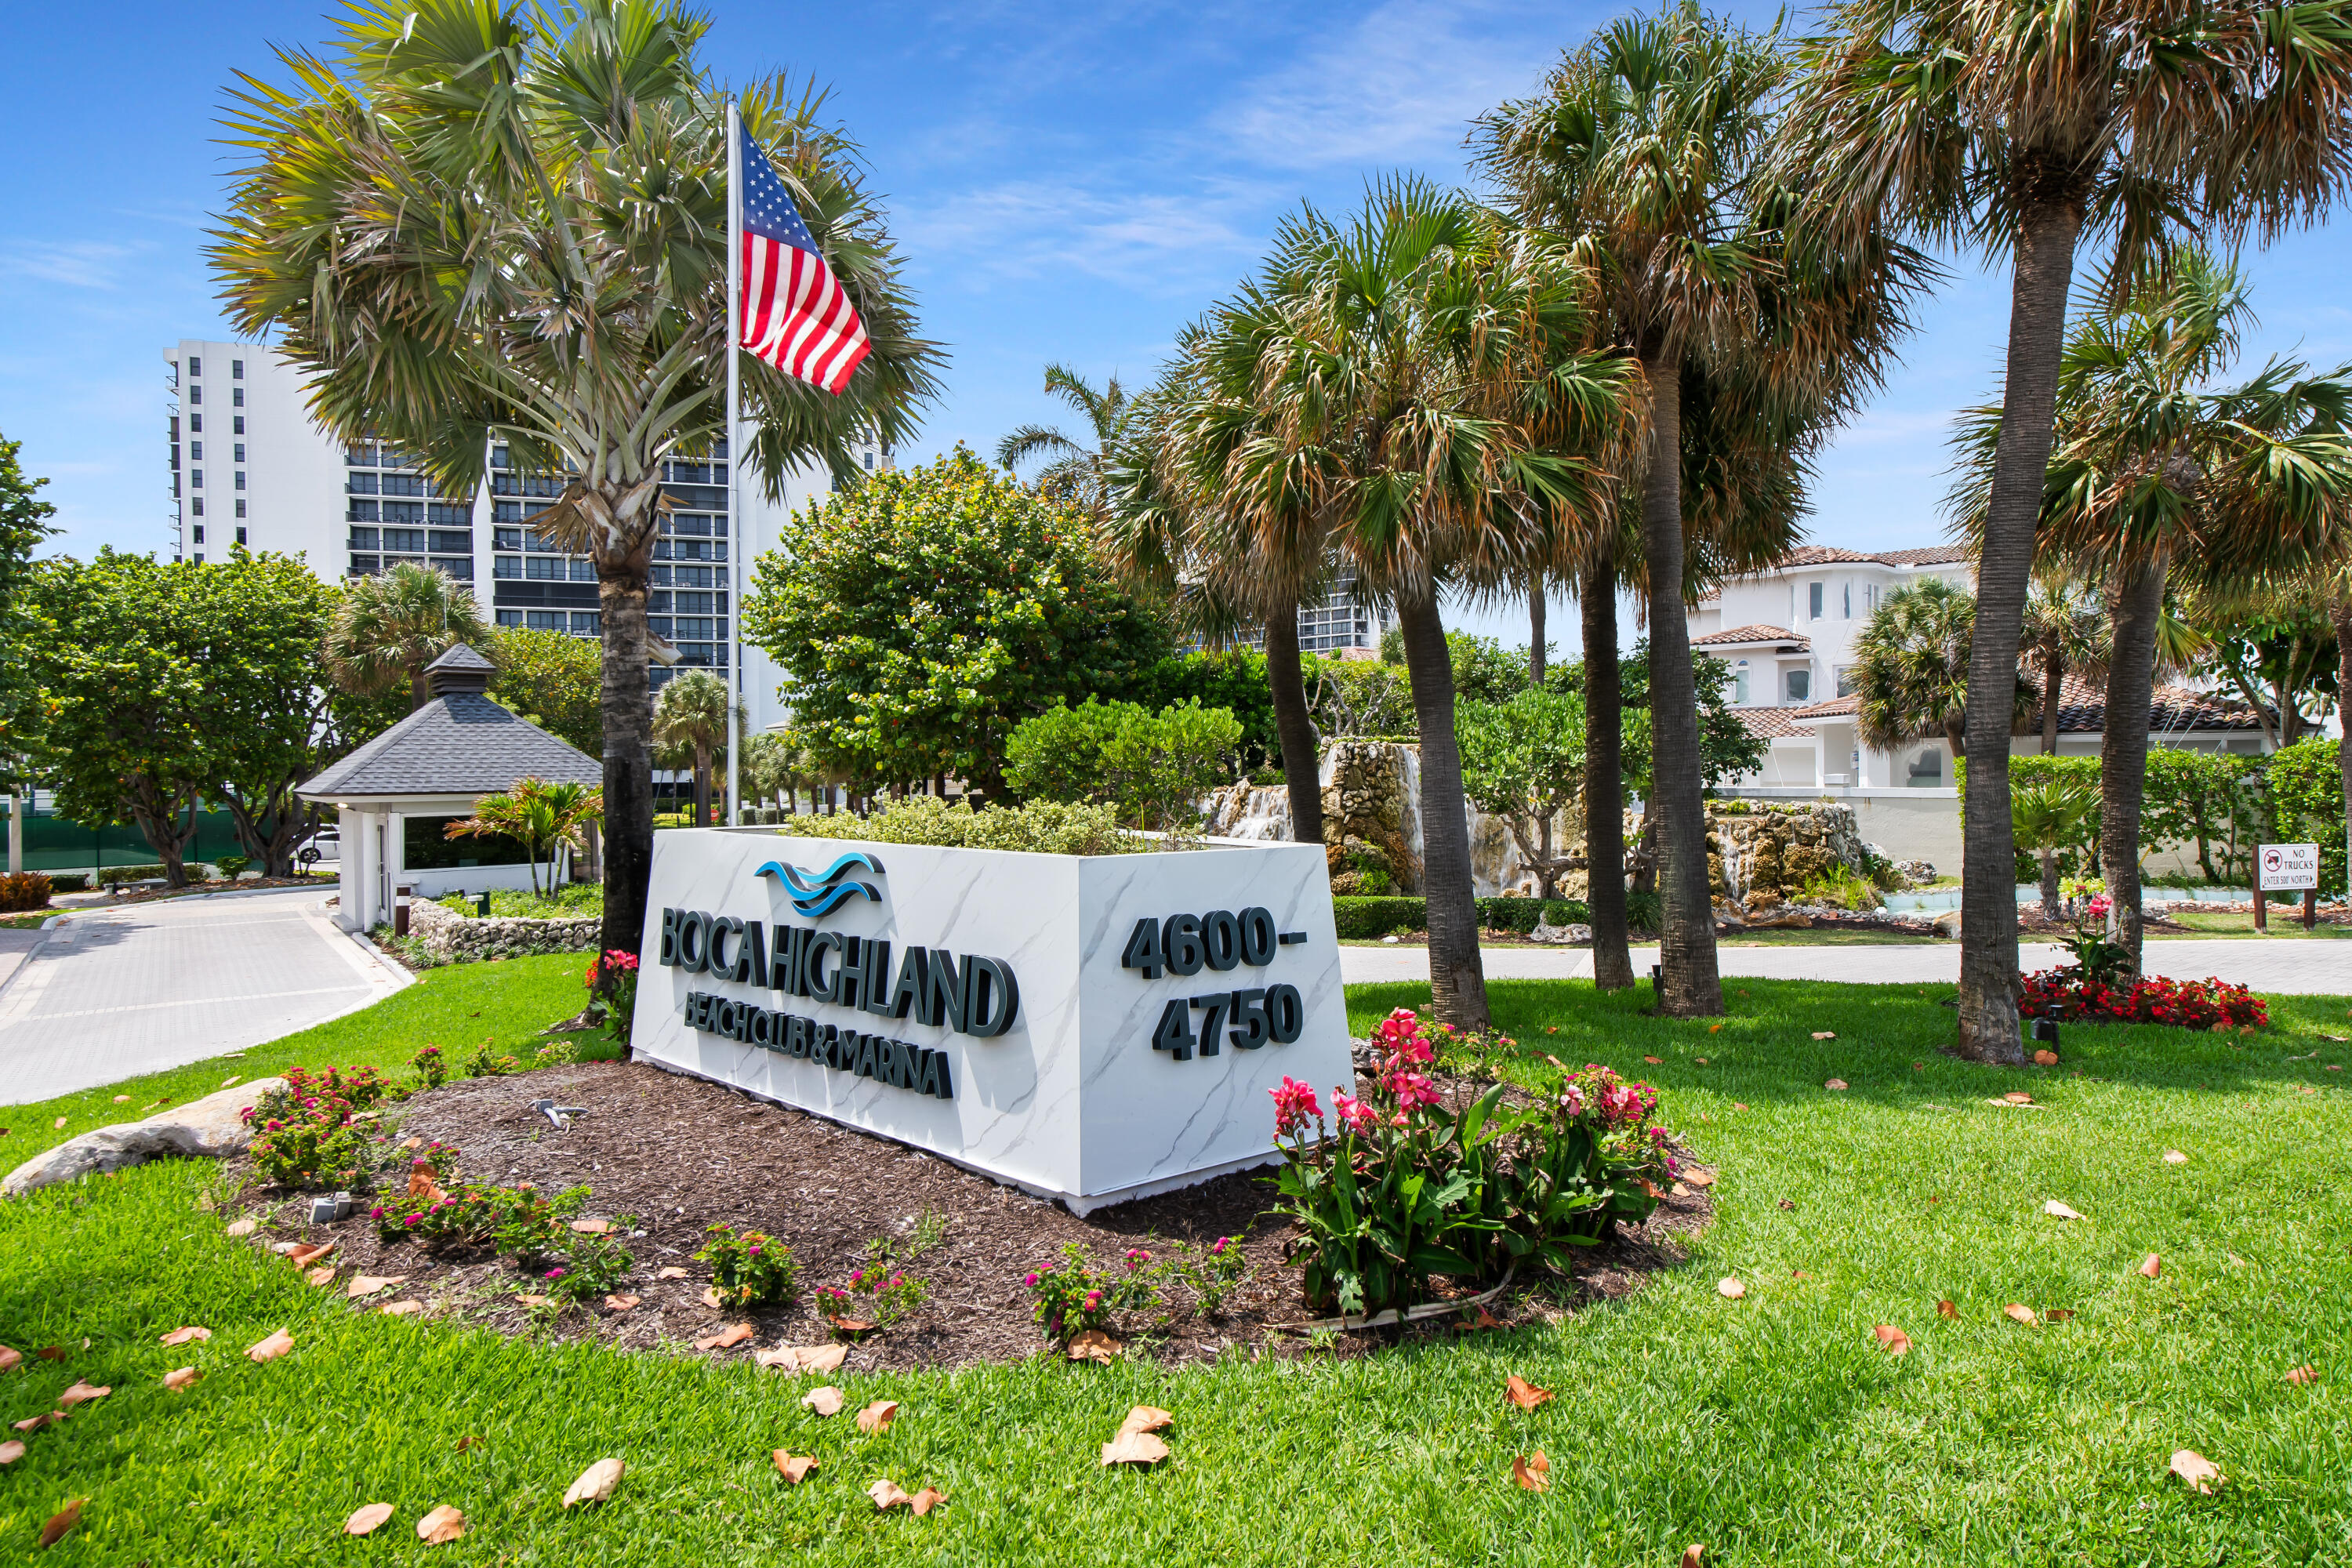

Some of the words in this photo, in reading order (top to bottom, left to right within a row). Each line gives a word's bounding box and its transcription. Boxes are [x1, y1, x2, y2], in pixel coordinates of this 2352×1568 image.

[2263, 876, 2280, 885] ENTER
[2291, 875, 2309, 884] NORTH
[2284, 860, 2314, 870] TRUCKS
[2293, 849, 2305, 858] NO
[659, 907, 768, 987] BOCA
[768, 924, 1019, 1038] HIGHLAND
[1121, 907, 1308, 979] 4600-
[684, 991, 760, 1044] BEACH
[751, 1010, 817, 1059] CLUB
[811, 1024, 838, 1068] &
[837, 1029, 953, 1099] MARINA
[1152, 983, 1303, 1061] 4750
